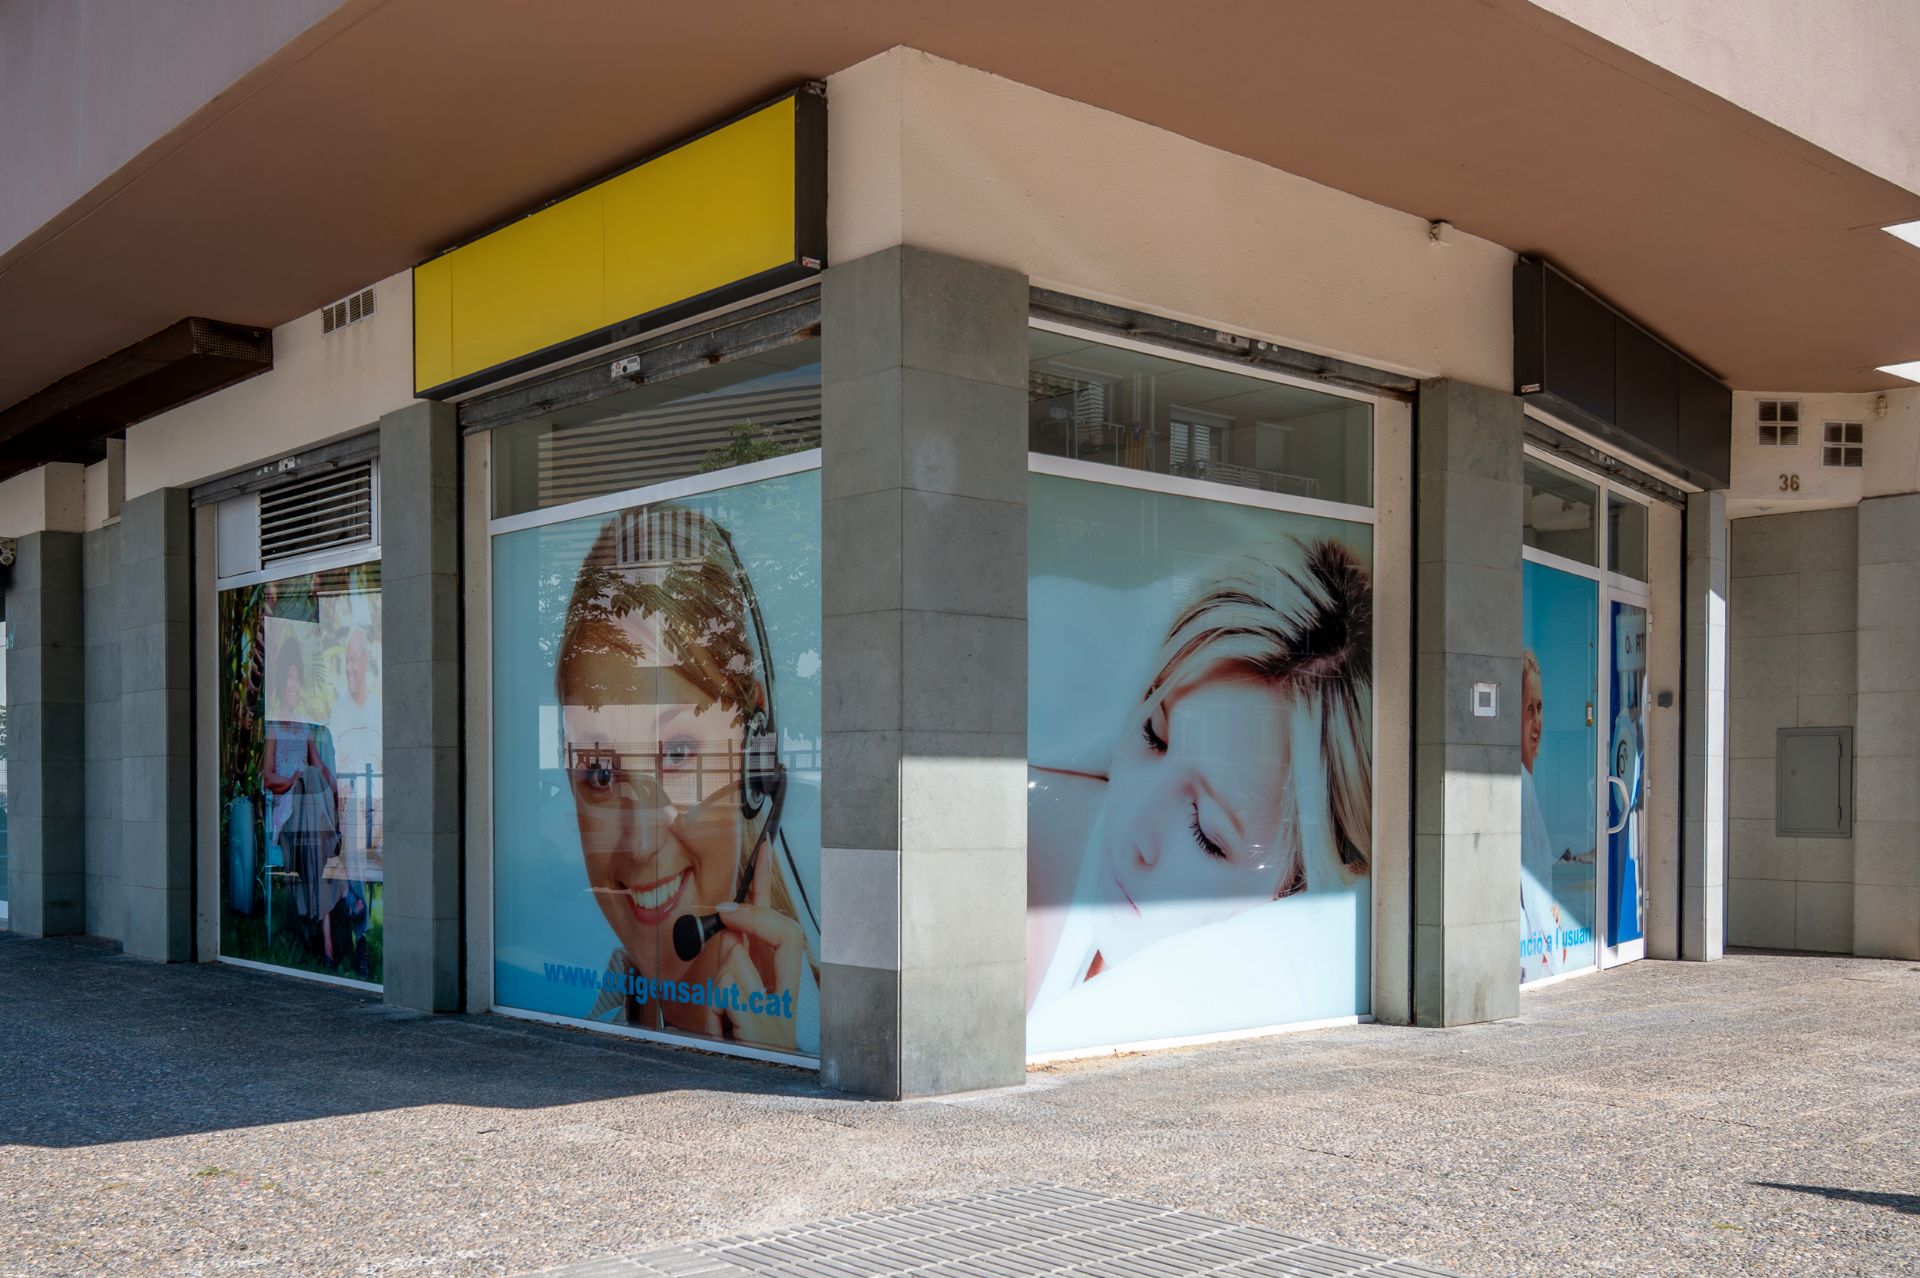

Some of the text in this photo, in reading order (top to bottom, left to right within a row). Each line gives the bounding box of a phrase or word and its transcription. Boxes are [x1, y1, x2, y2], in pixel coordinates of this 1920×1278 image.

[1779, 474, 1800, 492] 36
[1546, 934, 1552, 952] a
[543, 962, 792, 1018] www.oxigensalut.cat
